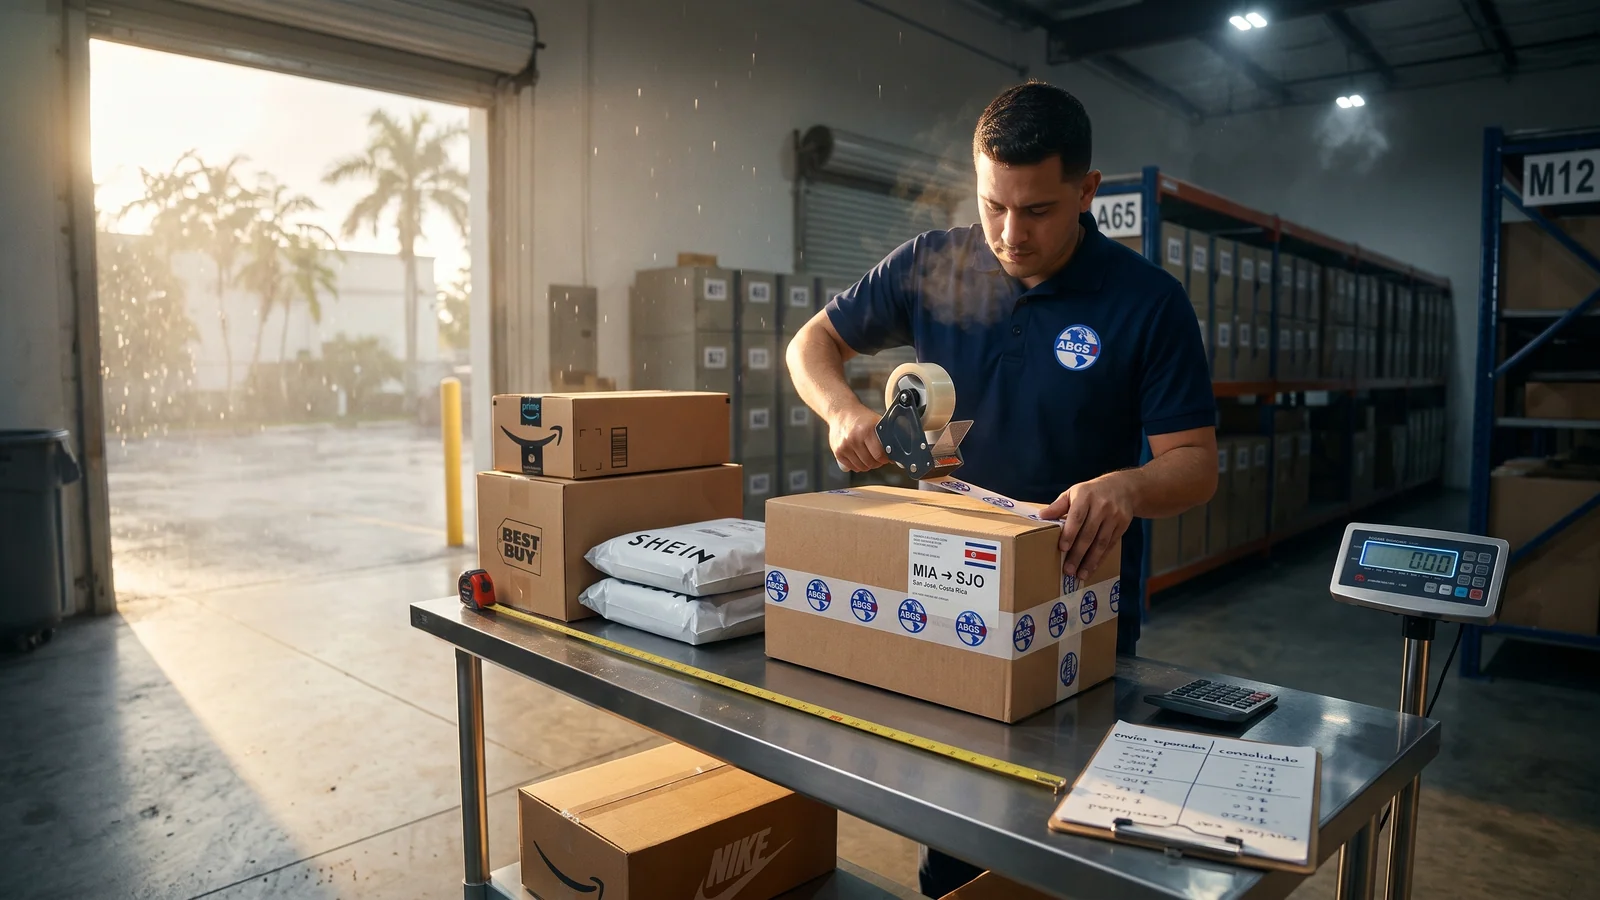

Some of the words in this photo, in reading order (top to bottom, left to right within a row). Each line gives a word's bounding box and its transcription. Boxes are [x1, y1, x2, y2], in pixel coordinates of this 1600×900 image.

[1529, 157, 1594, 197] M12
[1098, 201, 1136, 230] A65
[1057, 338, 1091, 354] ABGS
[522, 403, 540, 412] prime
[503, 526, 540, 552] BEST
[504, 543, 536, 566] BUY
[627, 534, 716, 565] SHEIN
[1409, 551, 1452, 574] 0.00
[913, 563, 938, 580] MIA
[956, 571, 985, 588] SJO
[766, 580, 784, 592] ABGS
[912, 579, 923, 587] San
[939, 584, 955, 593] Costa
[955, 587, 968, 595] Rica
[807, 589, 826, 601] ABGS
[852, 600, 872, 611] ABGS
[900, 610, 921, 622] ABGS
[1049, 614, 1064, 627] ABGS
[958, 622, 980, 634] ABGS
[1014, 628, 1031, 640] ABGS
[706, 826, 772, 889] NIKE
